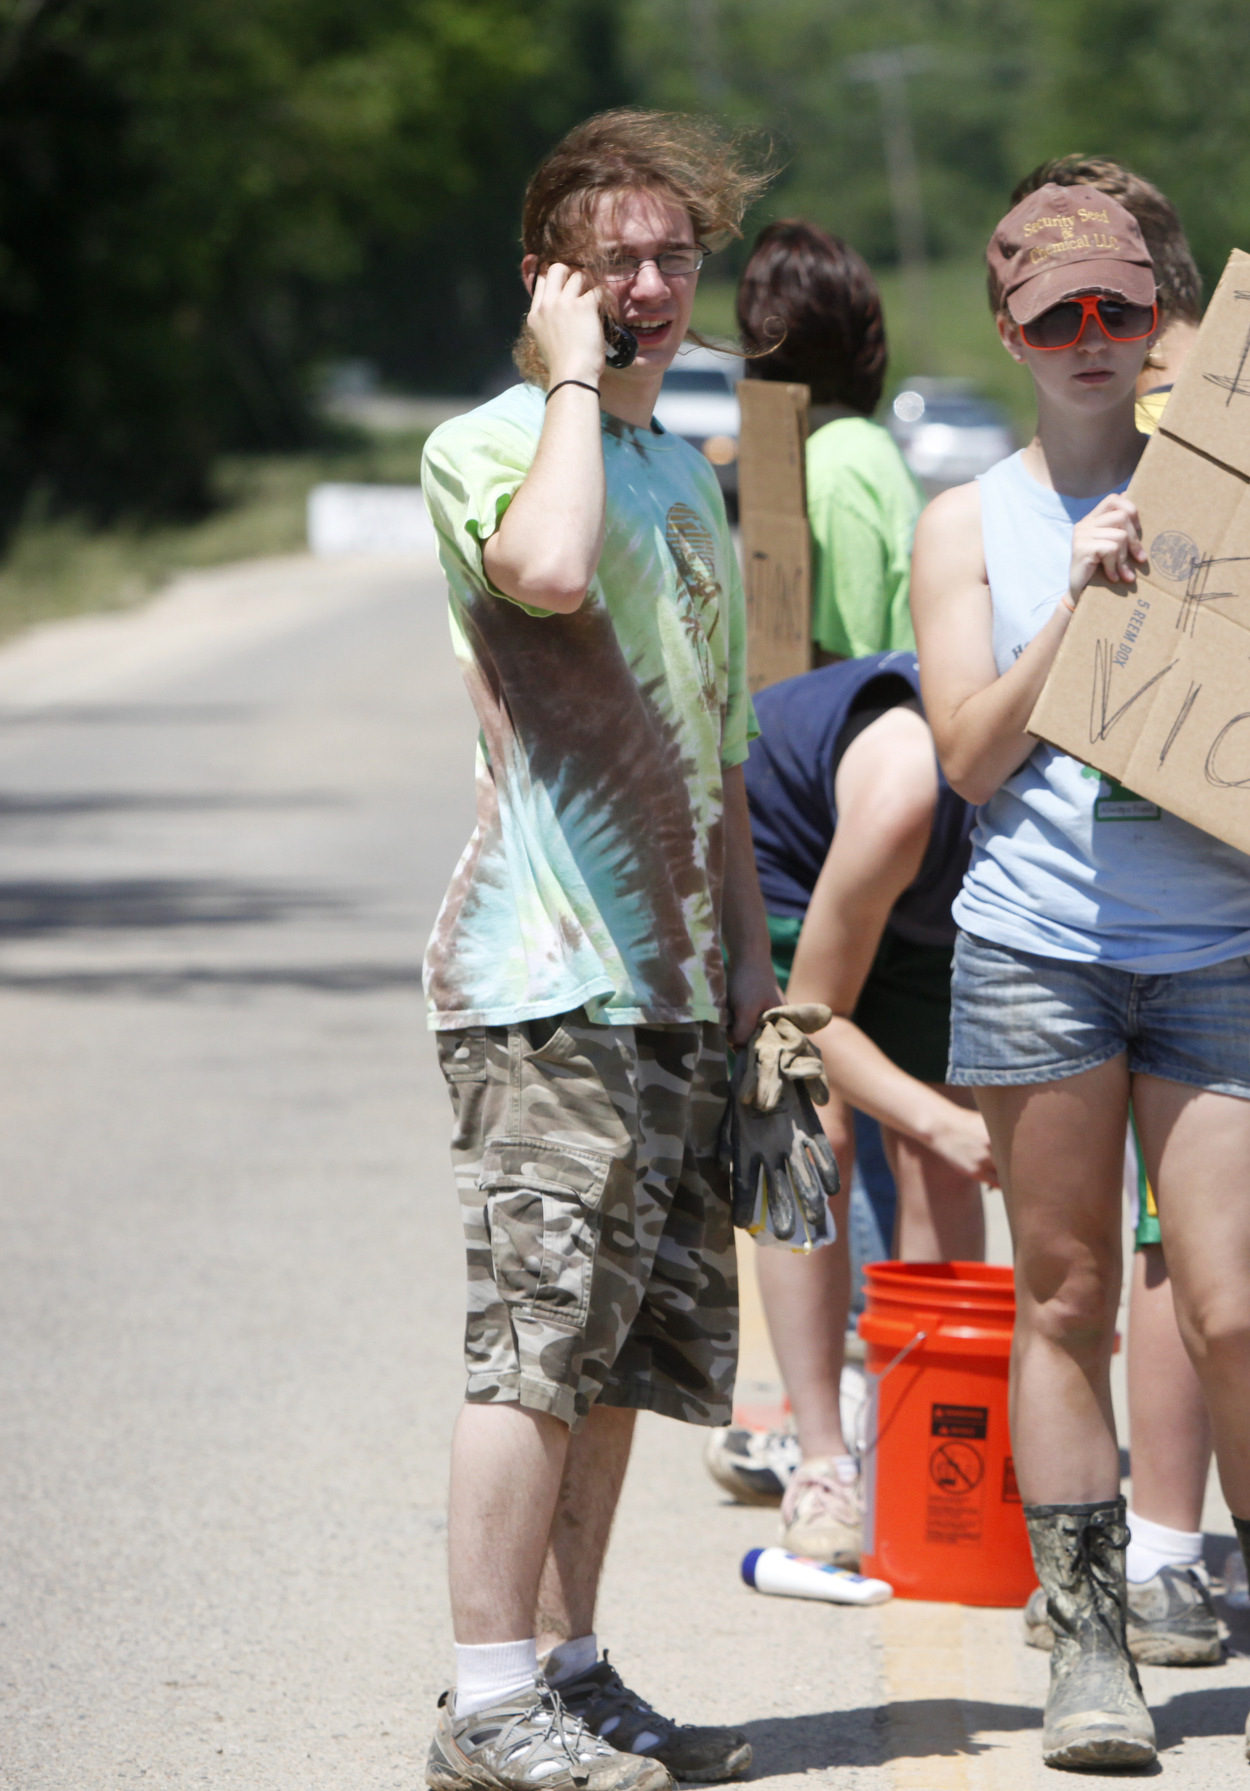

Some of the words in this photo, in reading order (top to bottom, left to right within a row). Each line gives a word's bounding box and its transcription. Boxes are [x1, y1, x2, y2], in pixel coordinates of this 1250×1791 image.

[1023, 214, 1075, 237] Security
[1029, 234, 1091, 264] Chemical
[1093, 233, 1120, 250] LLC
[1137, 599, 1151, 610] 5
[1123, 609, 1146, 643] REEM
[1112, 643, 1133, 668] BOX
